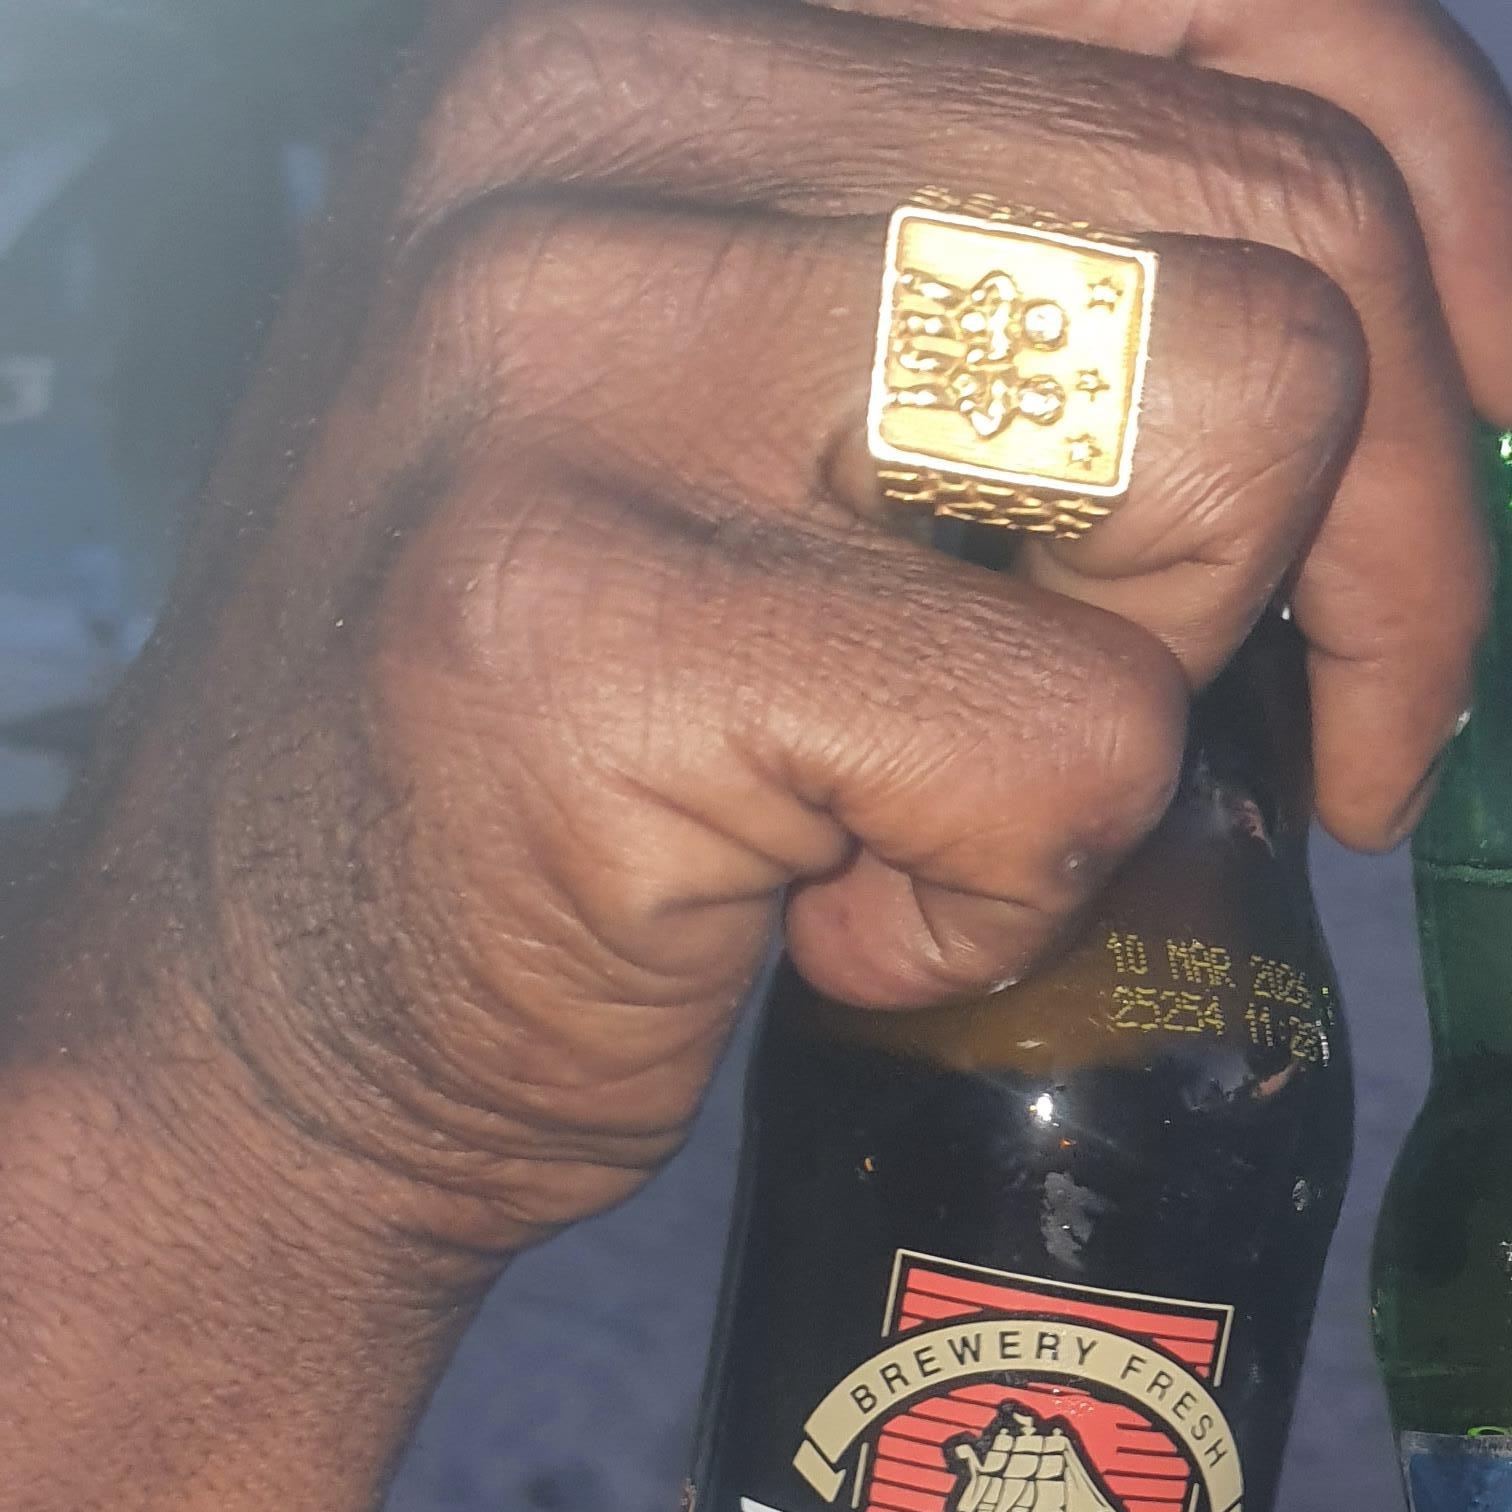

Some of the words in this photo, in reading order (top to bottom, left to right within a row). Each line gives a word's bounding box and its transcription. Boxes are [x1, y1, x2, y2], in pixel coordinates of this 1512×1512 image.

[1106, 931, 1149, 976] 10
[1166, 939, 1237, 988] MAR
[848, 1331, 1099, 1415] BREWERY
[1120, 1355, 1228, 1468] FRESH
